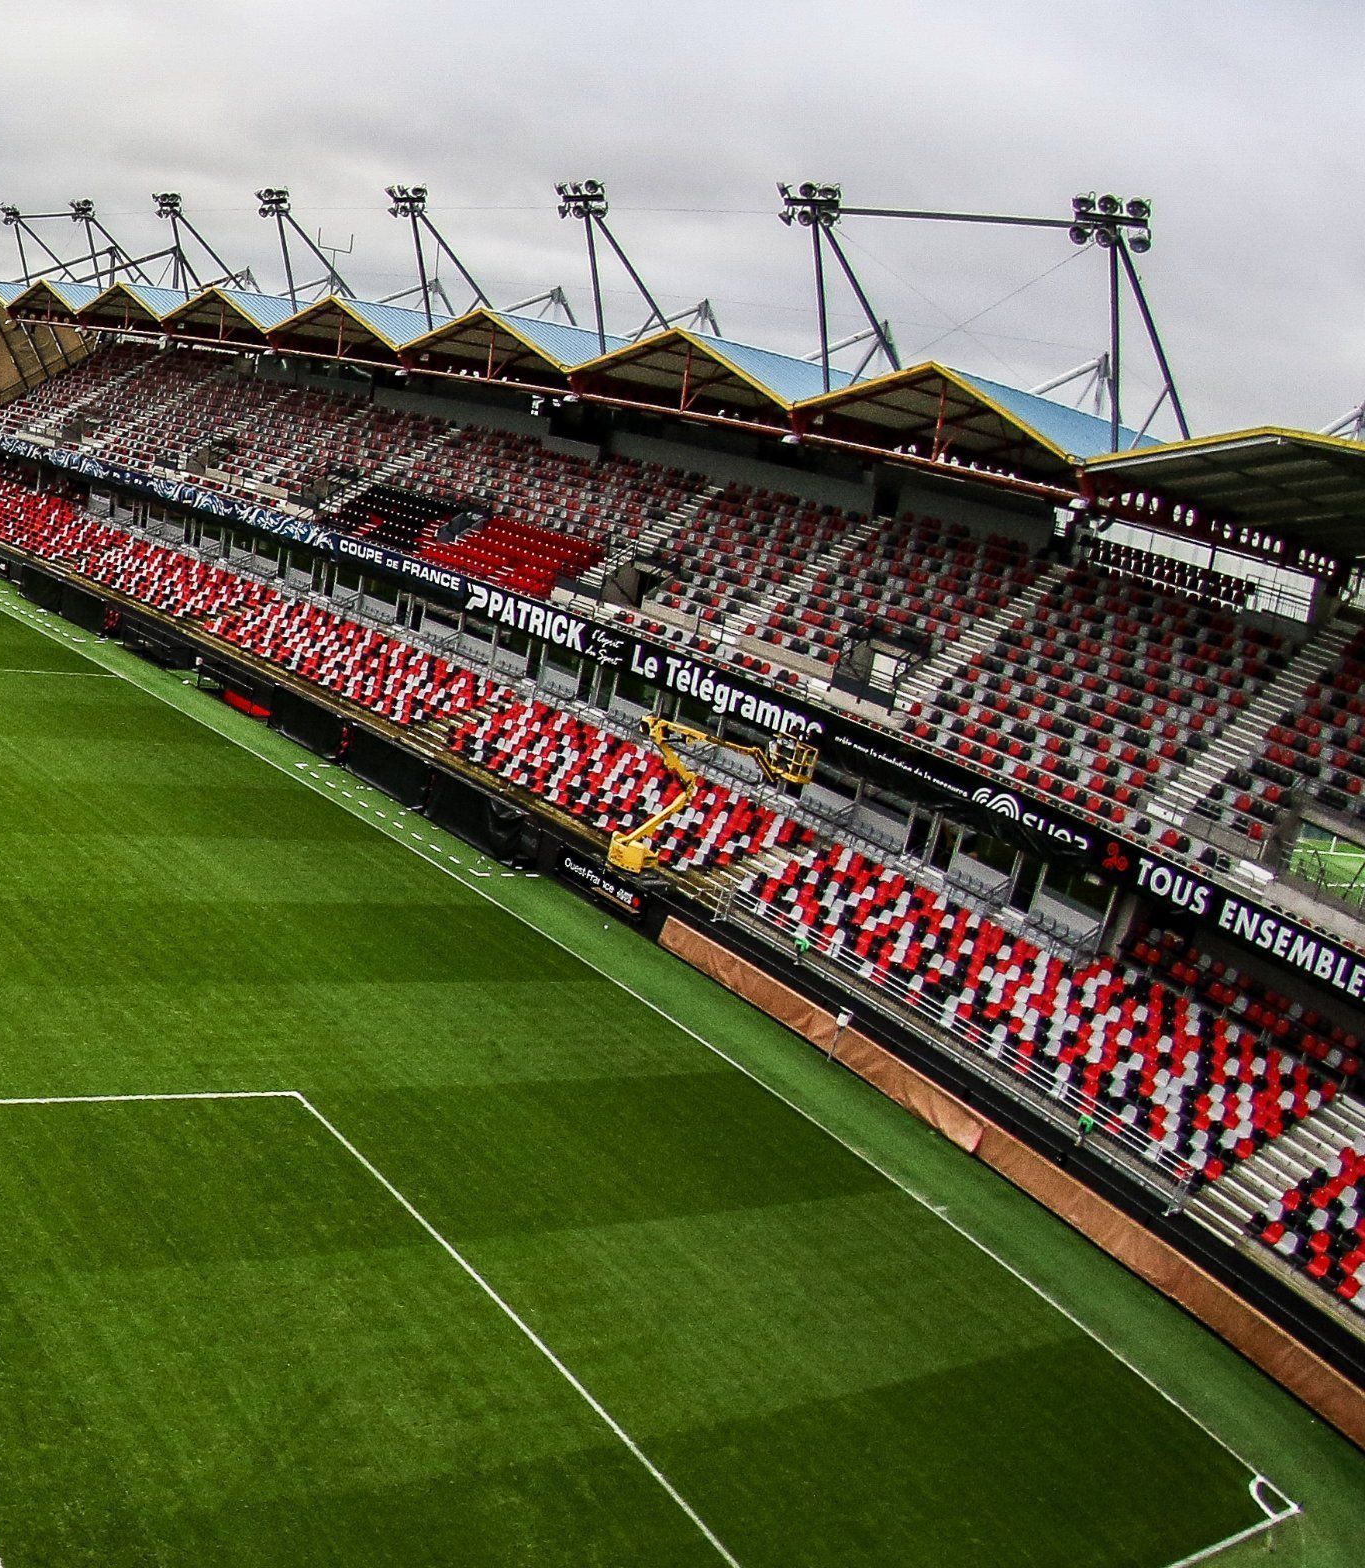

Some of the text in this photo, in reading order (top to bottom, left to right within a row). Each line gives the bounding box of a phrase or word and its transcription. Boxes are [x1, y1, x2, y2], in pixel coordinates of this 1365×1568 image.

[340, 540, 461, 591] COUPE DE FRANCE
[487, 588, 587, 651] PATRICK
[631, 644, 658, 678] Le
[1137, 857, 1365, 998] TOUS ENSEMBLE
